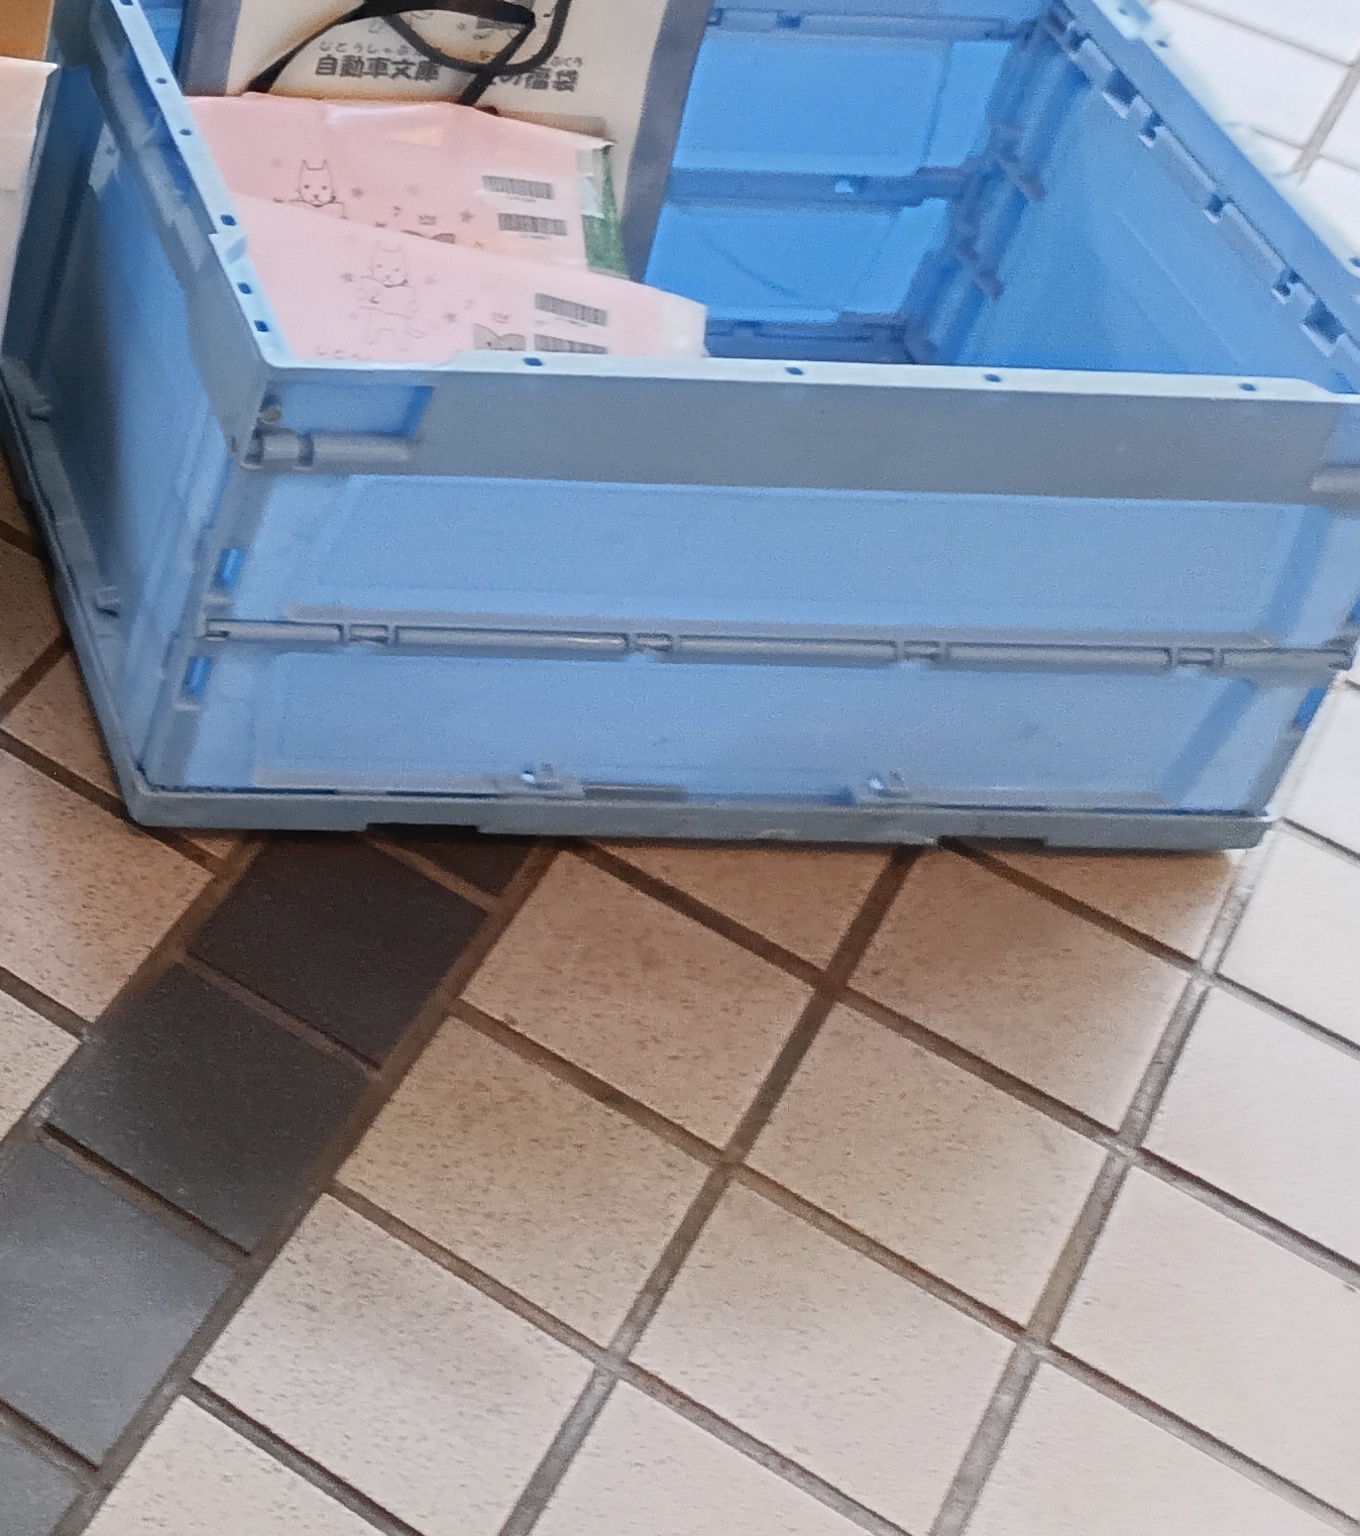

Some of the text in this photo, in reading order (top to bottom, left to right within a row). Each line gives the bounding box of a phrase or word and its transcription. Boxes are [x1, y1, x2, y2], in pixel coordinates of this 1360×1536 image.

[315, 54, 439, 81] 自動車文庫
